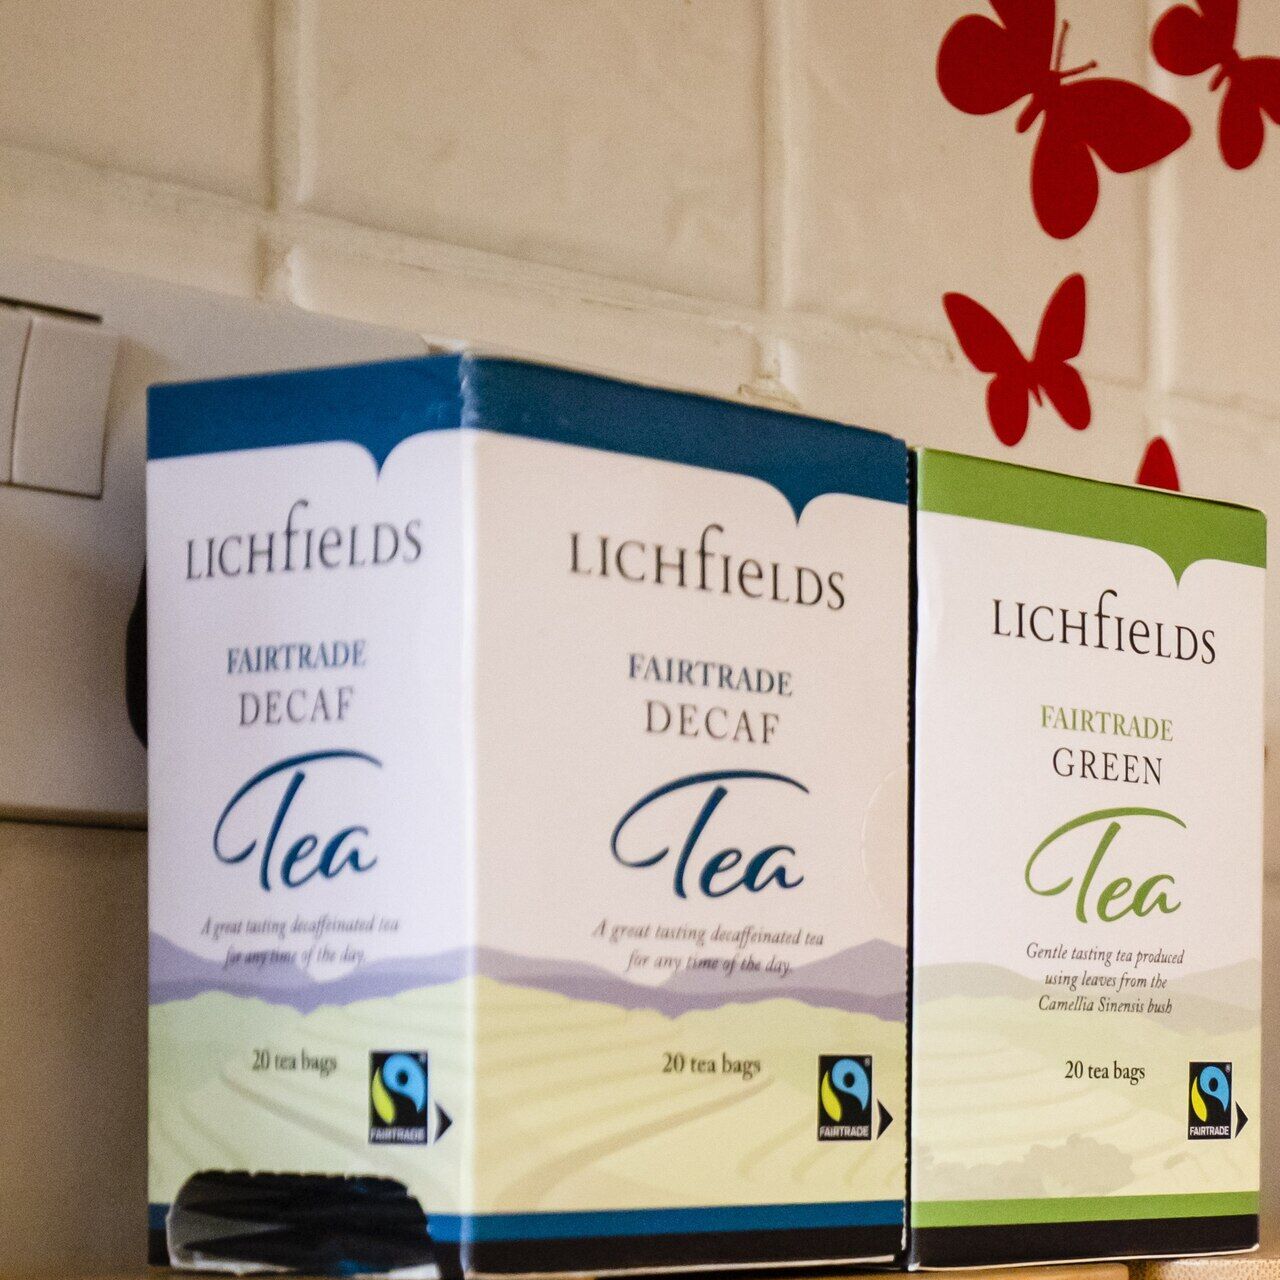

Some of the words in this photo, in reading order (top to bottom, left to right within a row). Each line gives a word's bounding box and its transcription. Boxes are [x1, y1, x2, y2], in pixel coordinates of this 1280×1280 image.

[226, 638, 366, 675] FAIRTRADE
[628, 653, 793, 697] FAIRTRADE
[239, 685, 354, 727] DECAF
[646, 700, 780, 744] DECAF
[1040, 704, 1174, 743] FAIRTRADE
[1052, 747, 1162, 786] GREEN
[213, 749, 383, 893] Tea
[610, 770, 810, 899] Tea
[1025, 806, 1188, 924] Tea
[201, 916, 212, 936] A
[212, 919, 243, 940] great
[245, 916, 286, 940] tasting
[290, 913, 375, 940] decaffeinated
[378, 916, 399, 933] tea
[592, 919, 606, 938] A
[609, 924, 650, 943] great
[655, 924, 707, 948] tasting
[710, 924, 802, 949] decaffeinated
[804, 930, 824, 947] tea
[223, 944, 243, 970] for
[244, 950, 267, 969] any
[270, 947, 297, 963] time
[317, 945, 337, 963] the
[625, 949, 650, 973] for
[653, 955, 682, 976] any
[686, 954, 719, 970] time
[721, 951, 740, 977] of
[740, 954, 761, 972] the
[1026, 942, 1068, 960] Gentle
[1071, 945, 1113, 967] tasting
[1115, 949, 1133, 962] tea
[1134, 948, 1185, 969] produced
[1045, 970, 1079, 991] using
[1081, 970, 1117, 988] leaves
[1116, 971, 1147, 992] from
[1150, 973, 1168, 989] the
[1038, 994, 1095, 1012] Camellia
[1098, 996, 1144, 1013] Sinensis
[1147, 997, 1172, 1014] bush
[252, 1049, 271, 1071] 20
[274, 1053, 297, 1071] tea
[301, 1050, 338, 1079] bags
[662, 1052, 685, 1074] 20
[690, 1056, 716, 1074] tea
[722, 1052, 762, 1080] bags
[1064, 1060, 1084, 1079] 20
[1088, 1063, 1109, 1079] tea
[1113, 1060, 1146, 1085] bags
[370, 1127, 427, 1141] FAIRTRADE
[819, 1126, 869, 1138] FAIRTRADE
[1189, 1125, 1229, 1136] FAIRTRADE
